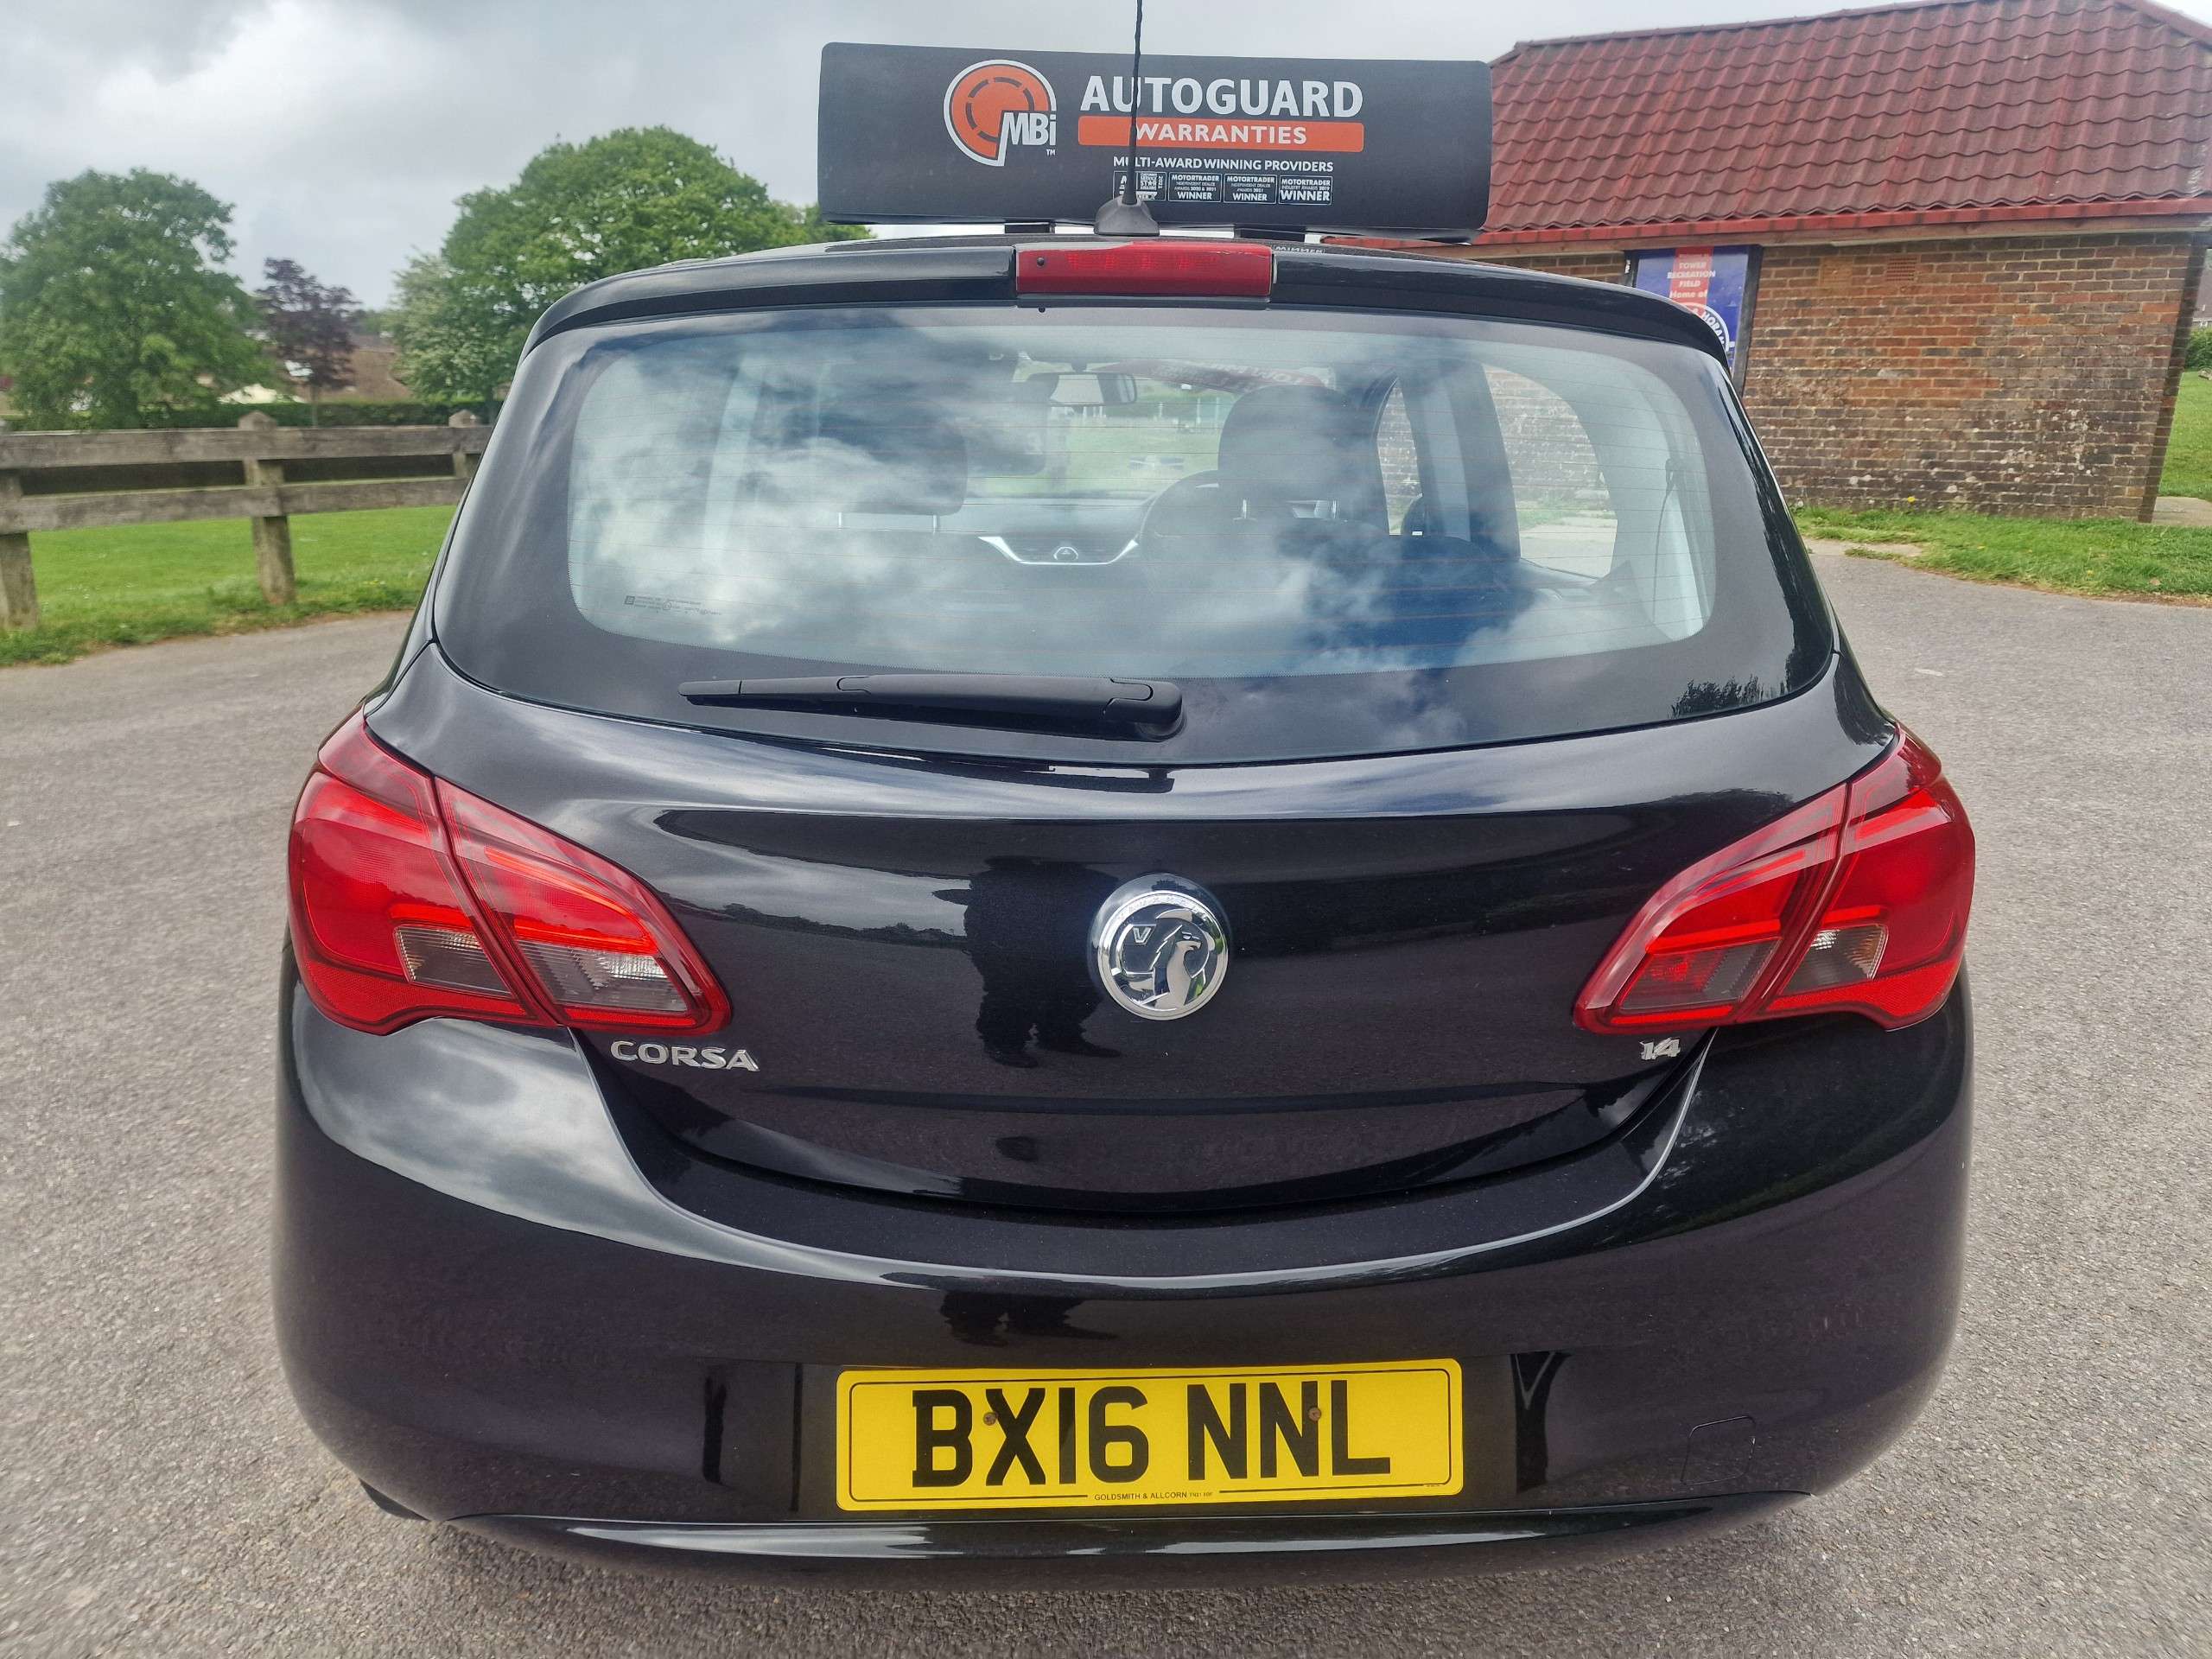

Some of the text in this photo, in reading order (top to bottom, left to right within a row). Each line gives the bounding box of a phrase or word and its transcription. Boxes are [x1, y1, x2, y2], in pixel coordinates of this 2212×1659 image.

[1080, 75, 1363, 118] AUTOGUARD
[1136, 123, 1307, 145] WARRANTIES
[1113, 156, 1334, 173] MLTI-AWARD WINNING PROVIDERS
[1177, 191, 1212, 200] WINNER
[1232, 193, 1268, 201] WINNER
[1280, 189, 1331, 201] WINNER
[610, 1040, 760, 1072] CORSA
[912, 1380, 1391, 1487] BX16 NNL
[1094, 1492, 1141, 1501] GOLDSMITH
